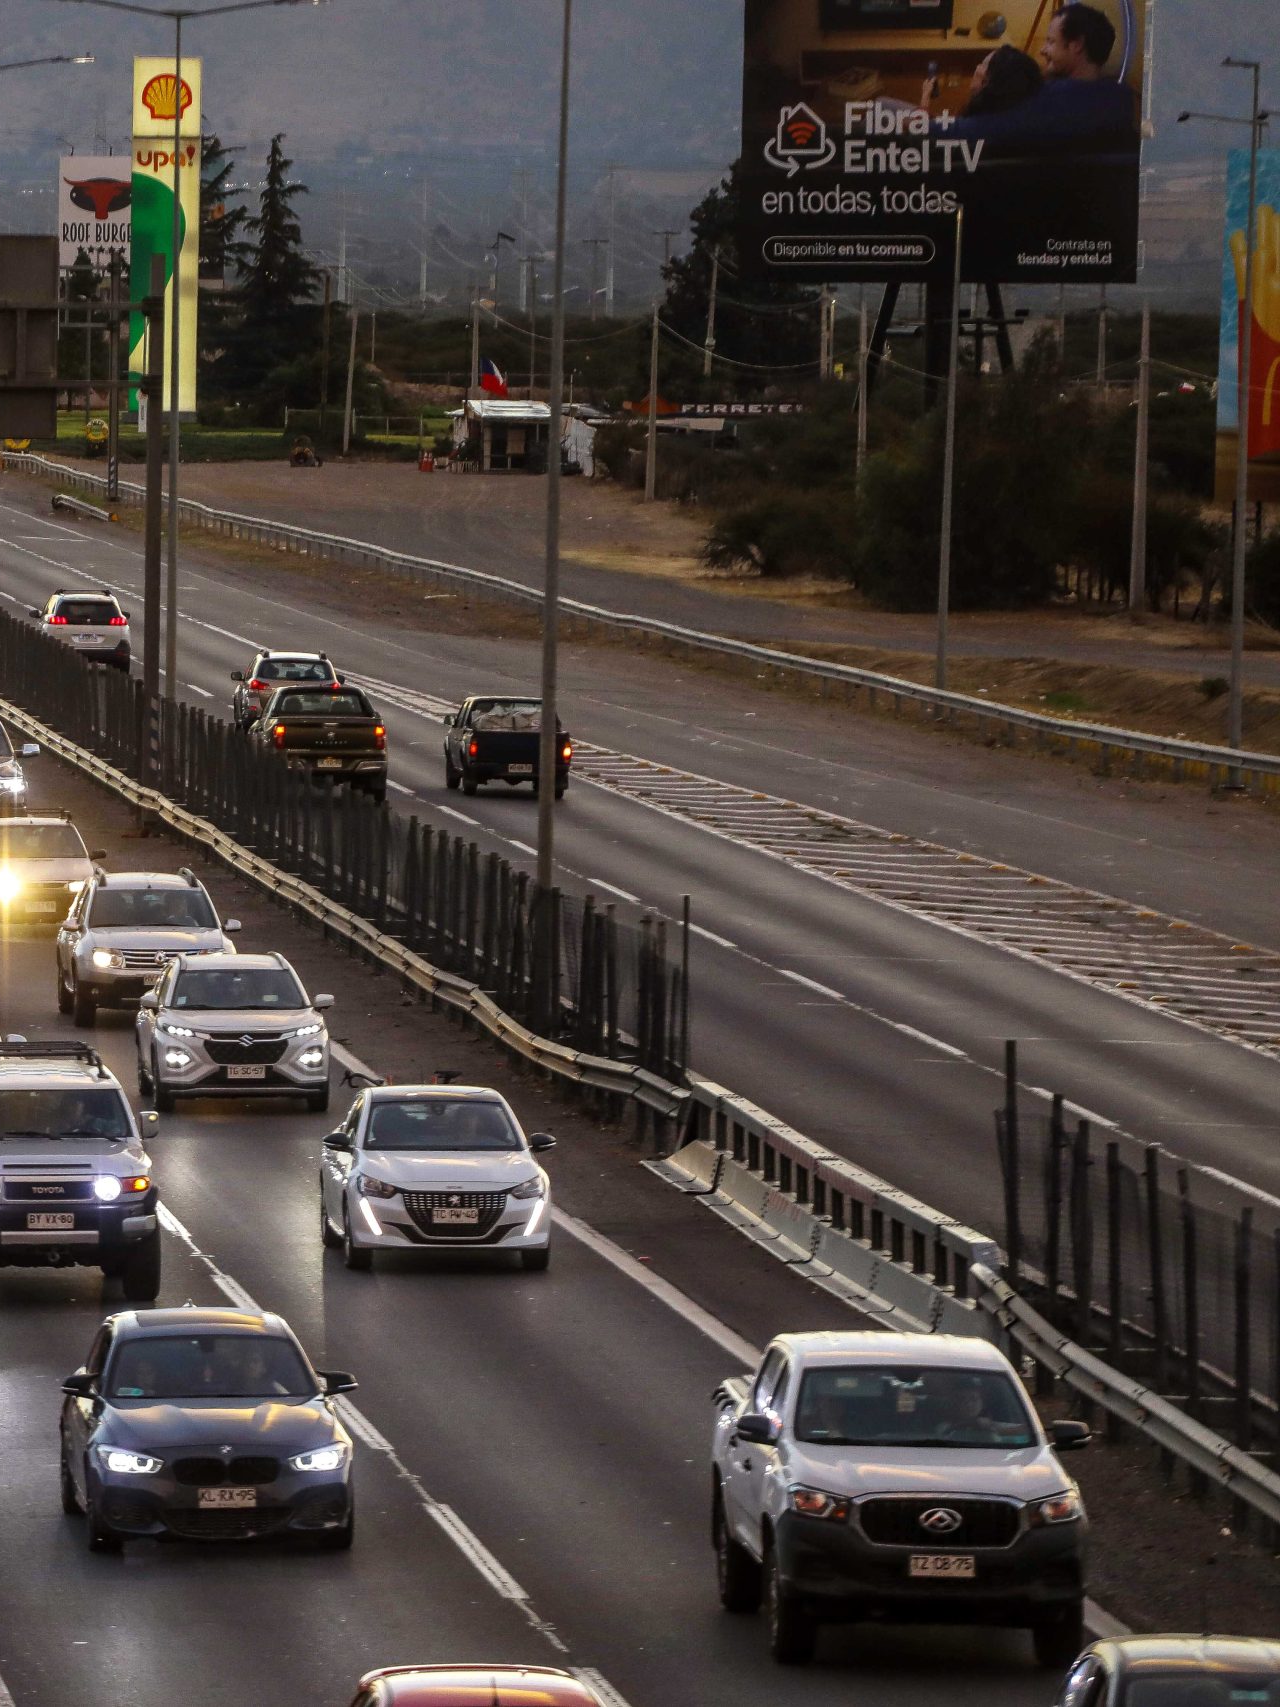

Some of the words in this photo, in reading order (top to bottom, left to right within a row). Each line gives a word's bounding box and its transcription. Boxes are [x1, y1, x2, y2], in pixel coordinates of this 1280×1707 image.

[844, 101, 930, 136] Fibra
[844, 139, 930, 173] Entel
[935, 139, 985, 173] TV
[762, 191, 794, 214] en
[797, 184, 878, 216] todas,
[62, 222, 90, 242] ROOF
[773, 242, 837, 258] Disponible
[837, 244, 854, 256] en
[855, 243, 870, 256] tu
[870, 244, 924, 256] comuna
[1046, 238, 1096, 251] Contrata
[1096, 240, 1112, 251] en
[1017, 252, 1060, 265] tiendas
[1061, 255, 1070, 267] y
[1070, 252, 1113, 265] entel.cl
[31, 1186, 66, 1194] TOYOTA
